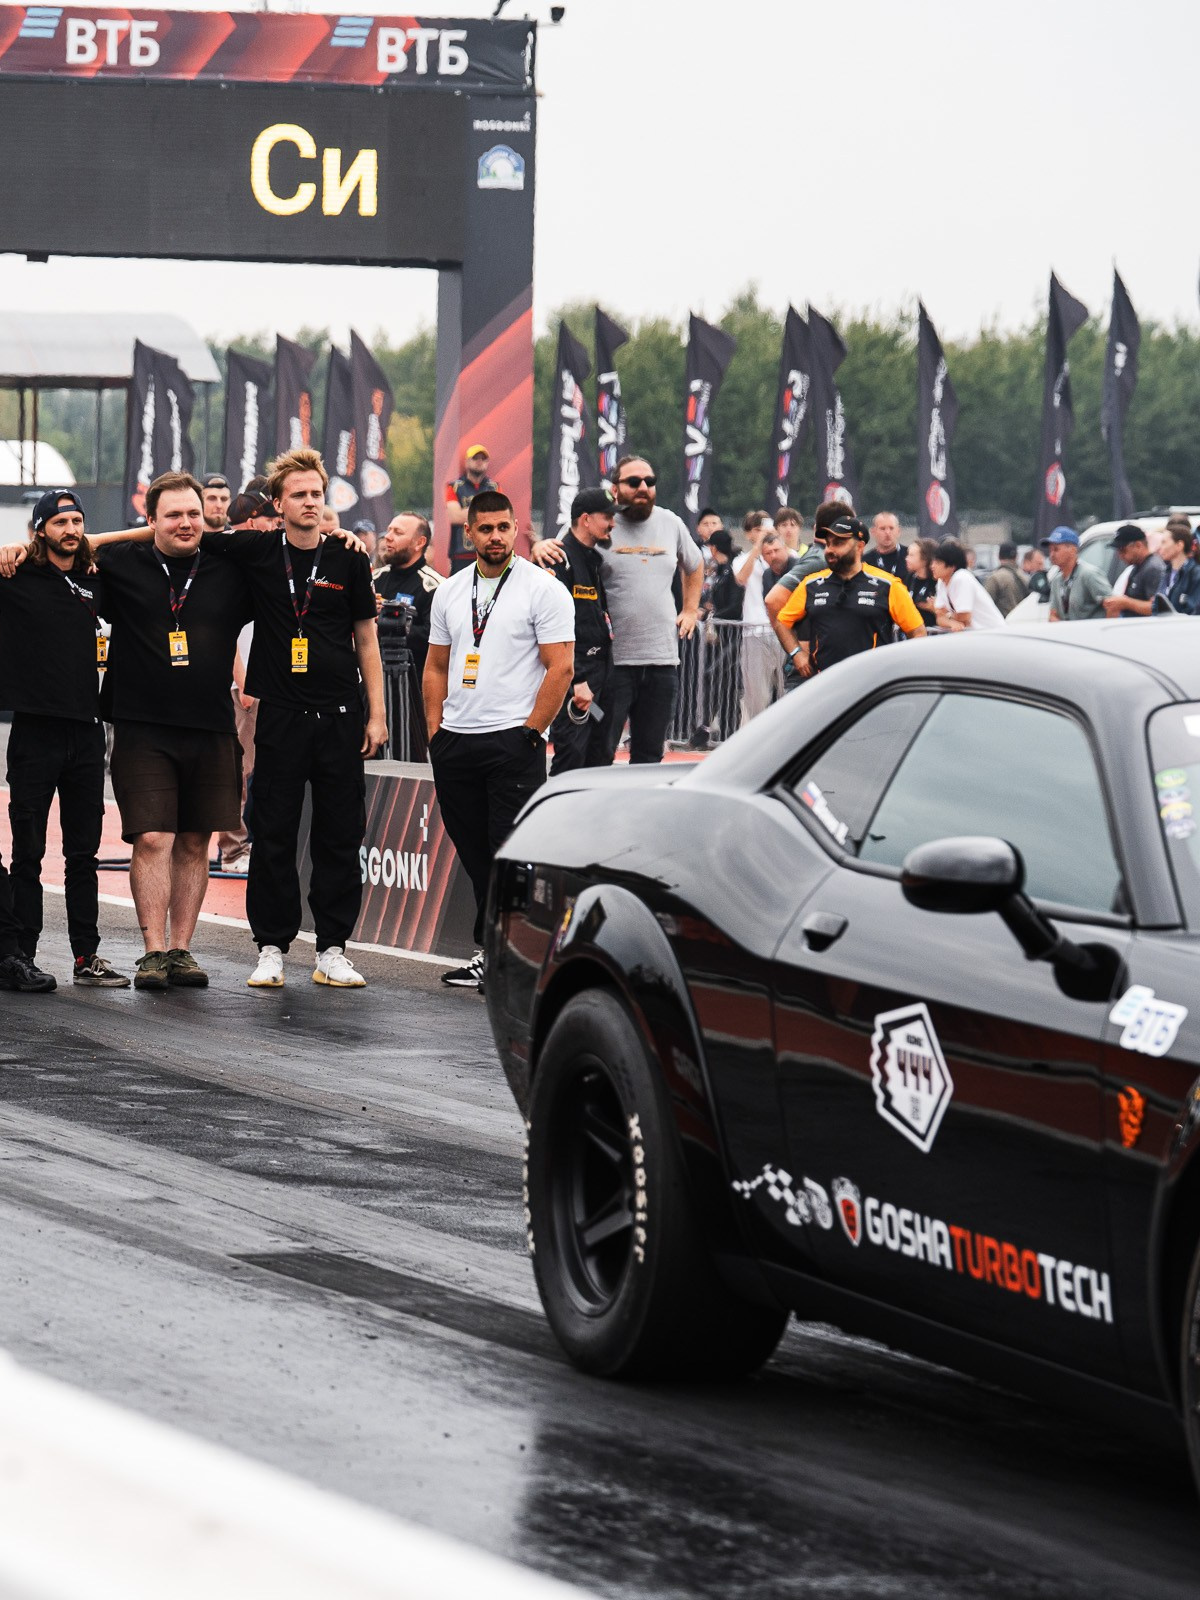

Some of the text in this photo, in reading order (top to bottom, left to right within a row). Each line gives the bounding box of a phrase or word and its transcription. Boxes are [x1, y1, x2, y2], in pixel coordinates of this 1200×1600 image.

[65, 17, 161, 66] ВТБ
[376, 27, 469, 75] ВТБ
[250, 123, 378, 217] Си
[864, 1196, 1114, 1324] GOSHATURBOTECH
